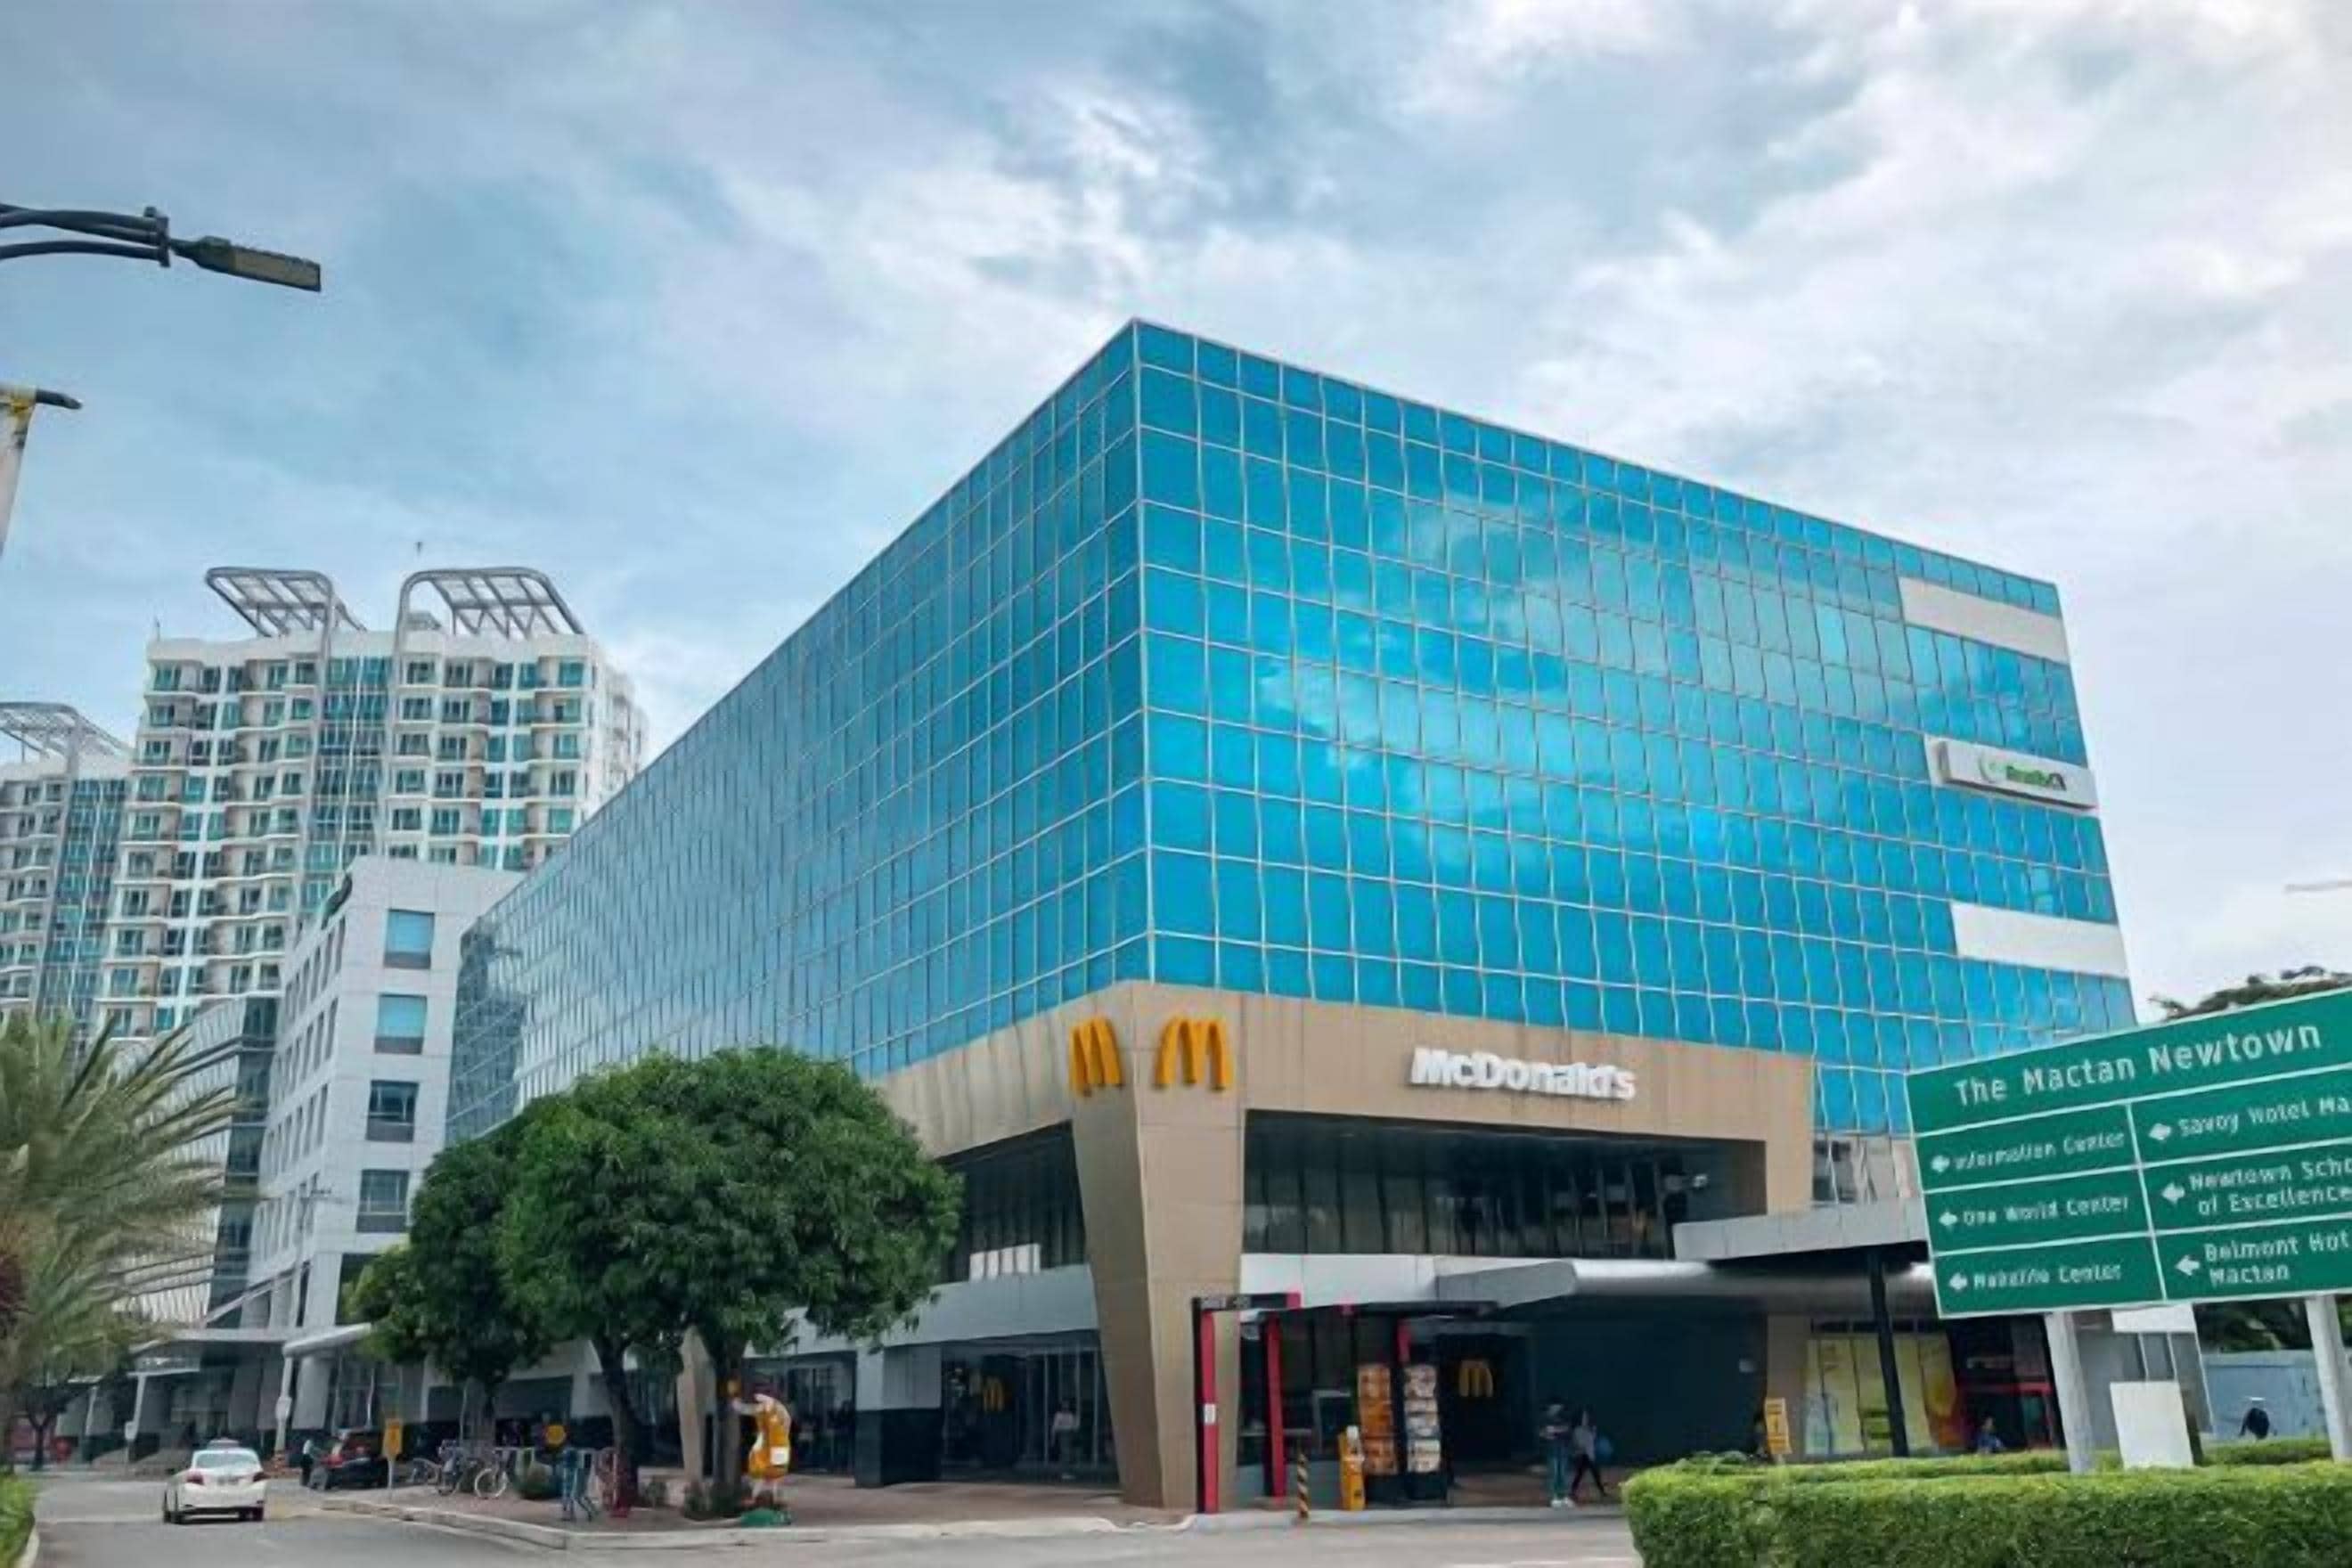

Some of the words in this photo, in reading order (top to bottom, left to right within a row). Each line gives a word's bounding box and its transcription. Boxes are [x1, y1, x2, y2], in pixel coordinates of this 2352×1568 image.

[1954, 1077, 2007, 1107] The
[2022, 1056, 2136, 1096] Mactan
[2147, 1024, 2322, 1075] Newtown
[2178, 1113, 2240, 1137] Savoy
[2247, 1100, 2310, 1125] Hotel
[2189, 1164, 2293, 1191] Newtown
[2066, 1196, 2129, 1217] Center
[2198, 1194, 2217, 1216] of
[2204, 1236, 2299, 1262] Belmont
[2209, 1263, 2291, 1288] Mactan
